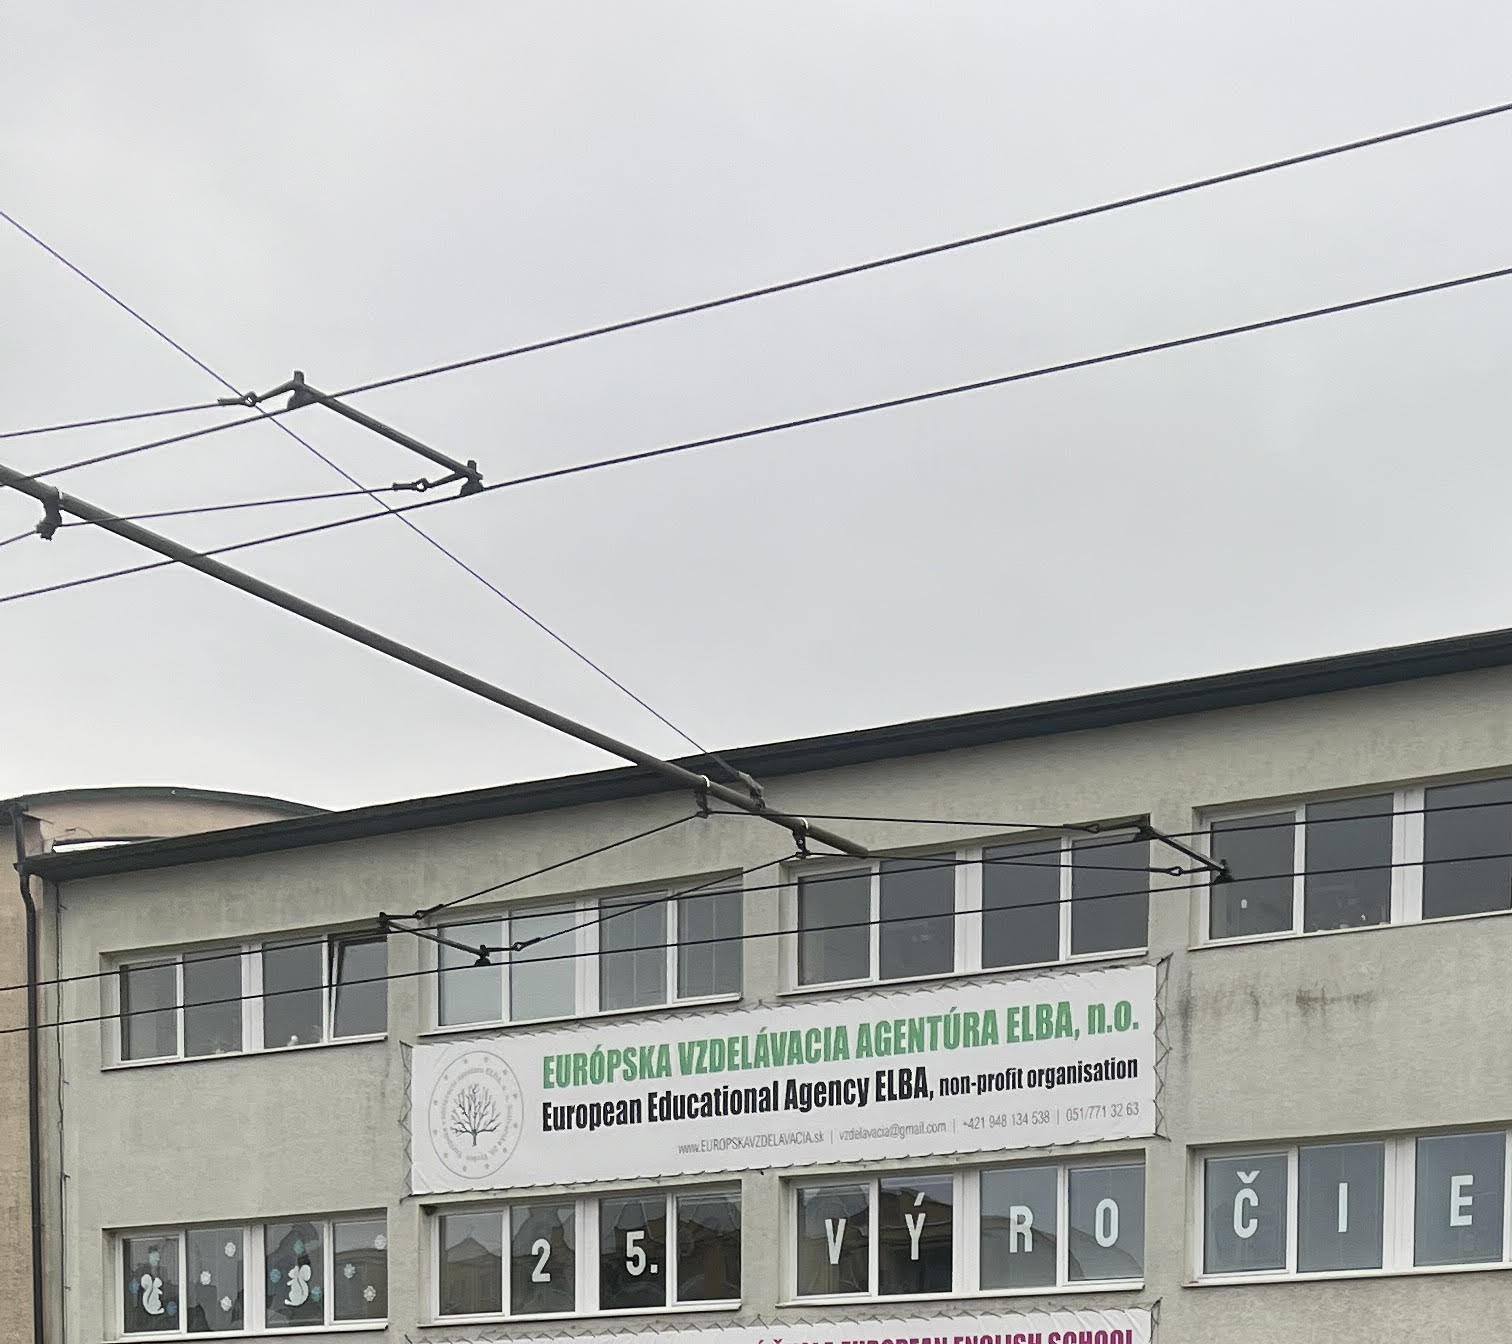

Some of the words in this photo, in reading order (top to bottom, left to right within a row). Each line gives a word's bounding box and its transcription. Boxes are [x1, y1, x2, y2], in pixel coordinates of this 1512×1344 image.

[543, 1044, 671, 1089] EURÓPSKA
[677, 1025, 850, 1076] VZDELÁVACIA
[855, 1006, 999, 1059] AGENTÚRA
[1005, 1000, 1080, 1044] ELBA,
[1087, 1000, 1139, 1036] n.o.
[542, 1098, 642, 1132] European
[647, 1082, 778, 1124] Educational
[784, 1075, 870, 1113] Agency
[874, 1066, 934, 1101] ELBA,
[939, 1067, 1023, 1098] non-profit
[1026, 1057, 1138, 1090] organisation
[677, 1130, 824, 1154] www.EUROPSKAVZDELAVACIA.sk
[839, 1120, 946, 1141] vzdelavacia@gmail.com
[963, 1116, 985, 1130] +421
[988, 1114, 1007, 1129] 948
[1011, 1112, 1028, 1126] 134
[1031, 1110, 1050, 1125] 538
[1066, 1105, 1106, 1122] 051/771
[1110, 1103, 1124, 1117] 32
[1126, 1101, 1140, 1116] 63
